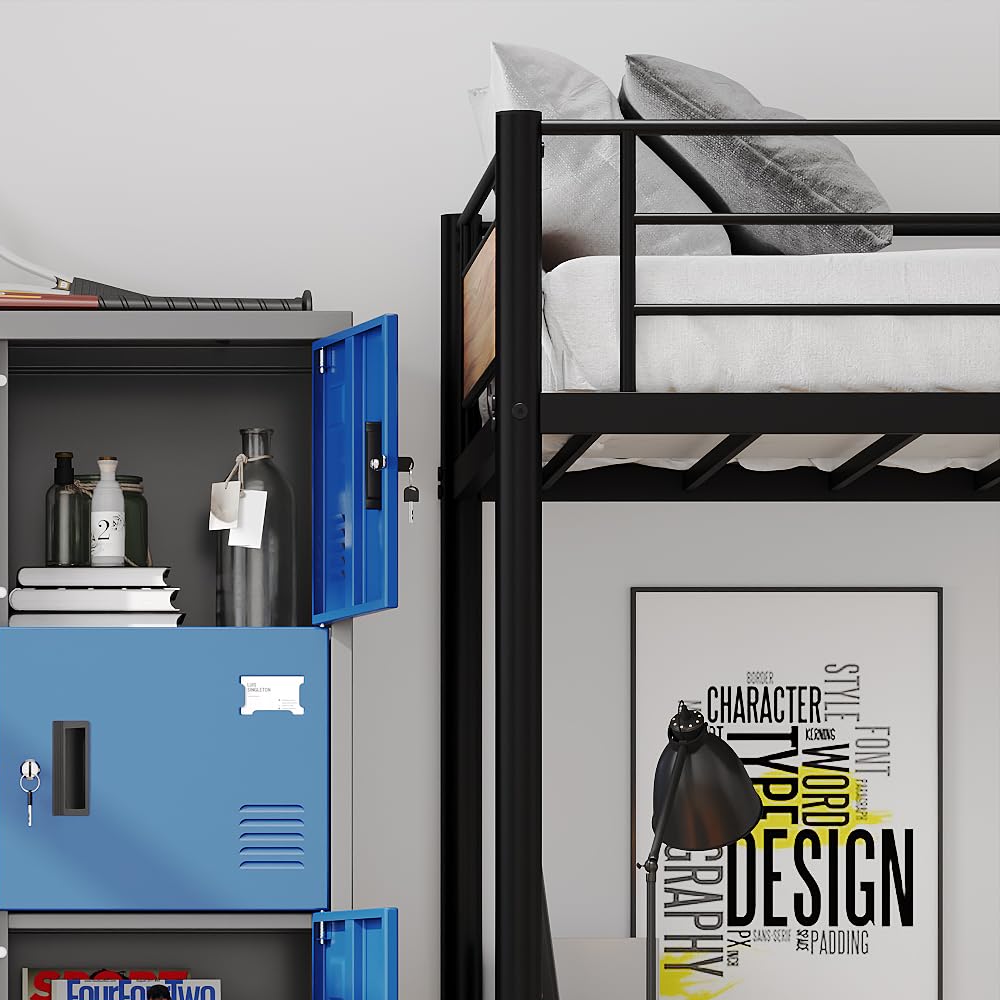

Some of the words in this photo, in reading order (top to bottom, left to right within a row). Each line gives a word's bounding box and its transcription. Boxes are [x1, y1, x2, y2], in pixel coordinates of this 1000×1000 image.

[707, 685, 822, 723] CHARACTER
[824, 663, 860, 722] STYLE
[727, 726, 799, 825] TYPE
[855, 726, 891, 776] FONT
[802, 743, 850, 826] WORD
[727, 829, 914, 927] DESIGN
[664, 846, 724, 977] GRAPHY
[727, 930, 752, 947] PX
[811, 930, 869, 954] PADDING
